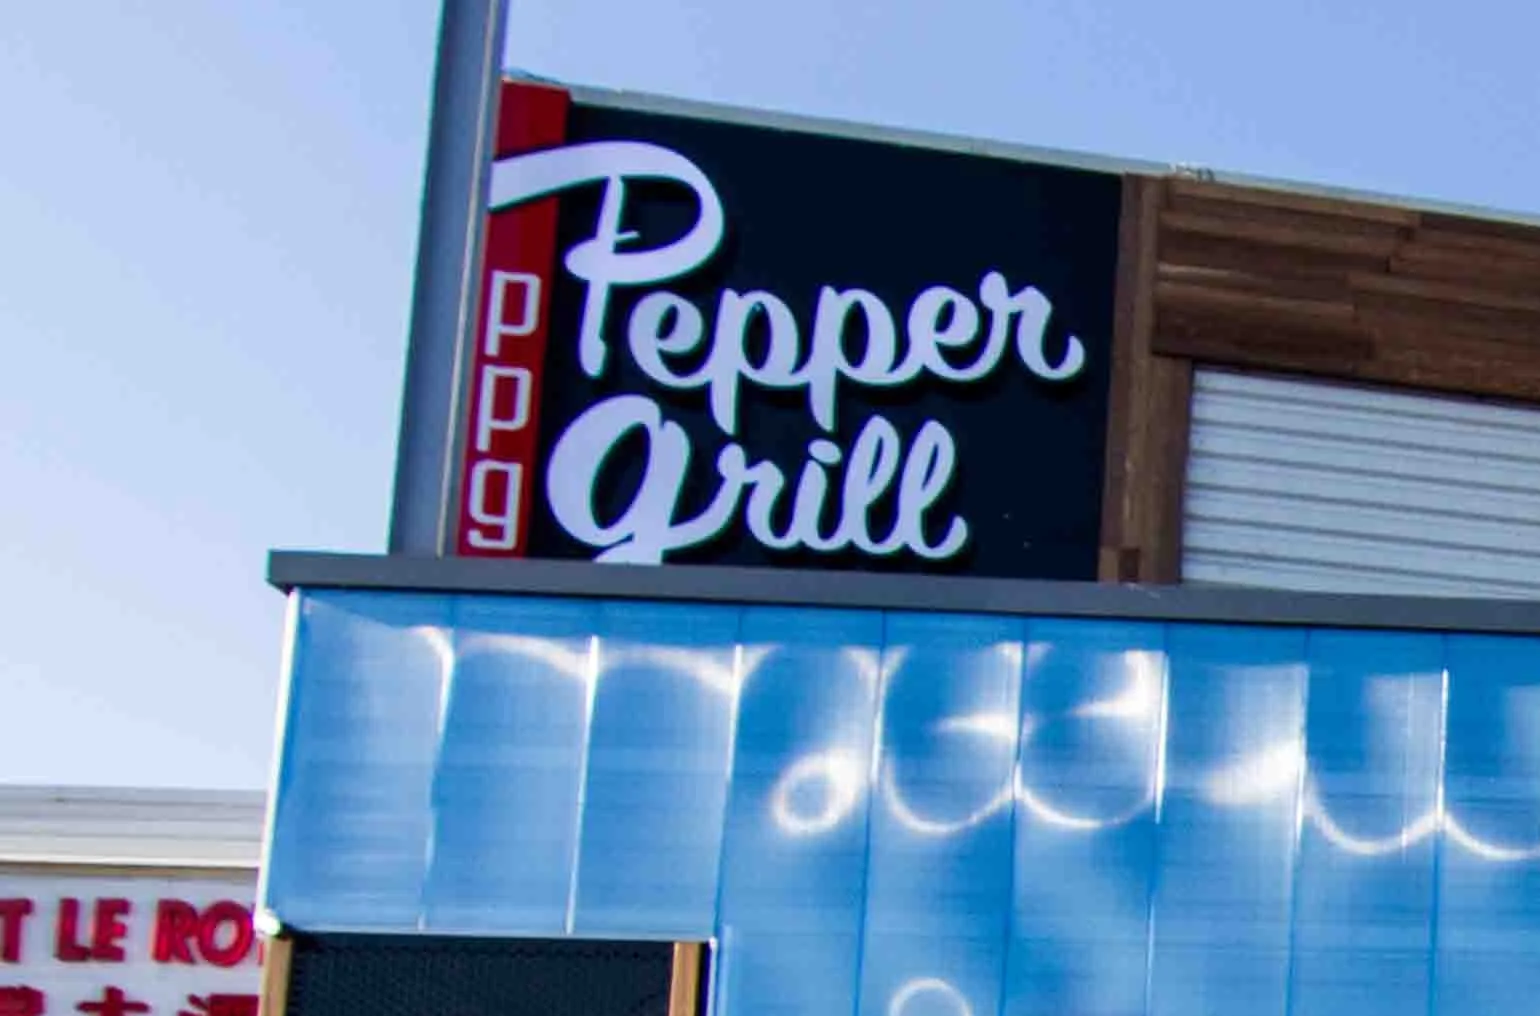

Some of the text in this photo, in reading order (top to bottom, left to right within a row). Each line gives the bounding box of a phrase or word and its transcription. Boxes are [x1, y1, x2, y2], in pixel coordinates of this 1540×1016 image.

[489, 141, 1086, 434] Pepper
[467, 271, 541, 550] ppg
[546, 396, 968, 565] grill
[55, 897, 132, 962] LE
[151, 898, 264, 968] RO
